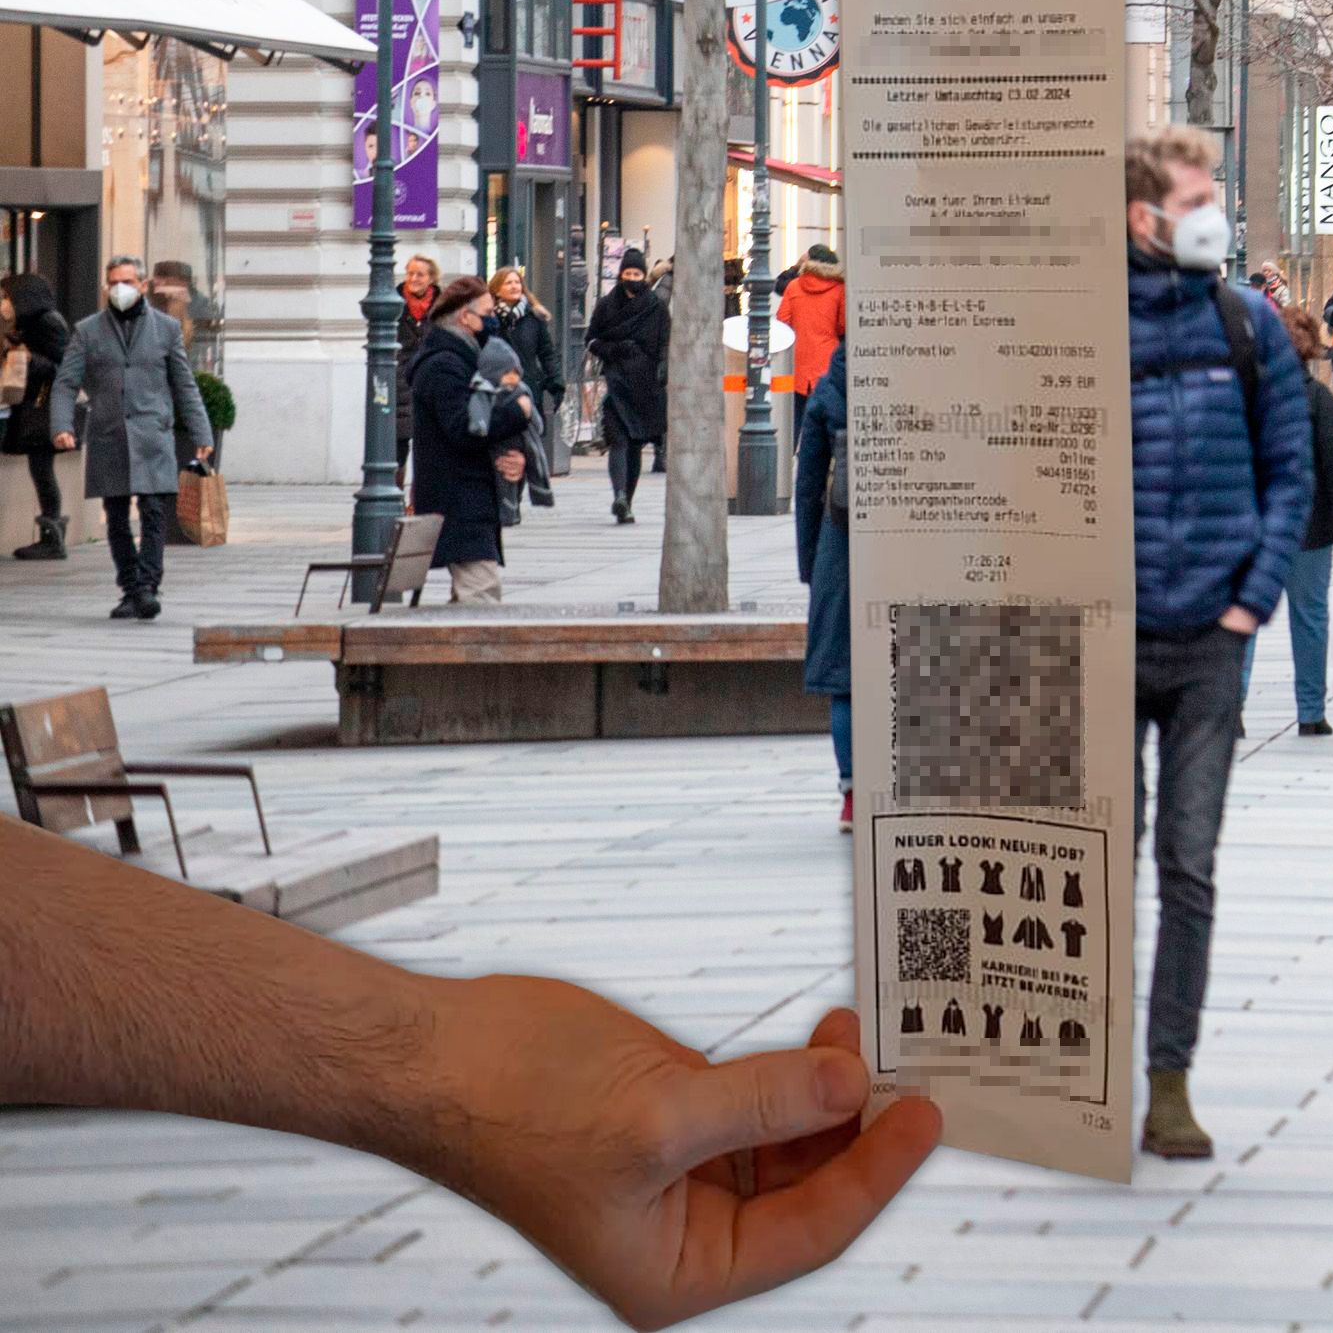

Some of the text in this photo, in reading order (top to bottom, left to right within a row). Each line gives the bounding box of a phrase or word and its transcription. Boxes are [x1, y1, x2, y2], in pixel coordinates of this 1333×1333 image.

[916, 13, 934, 26] Sie
[970, 12, 1014, 26] einfach
[743, 29, 840, 70] VENNA
[887, 89, 928, 103] Letzter
[934, 89, 1003, 103] Umtauschtag
[863, 119, 882, 132] Die
[887, 119, 960, 133] gesetzlichen
[923, 135, 966, 148] bleiben
[905, 195, 937, 208] Danke
[972, 195, 1004, 207] Ihren
[858, 315, 1016, 329] Bezahlung American Express
[853, 345, 956, 358] Zusatzinformation
[853, 376, 889, 389] Betrag
[1077, 376, 1096, 389] EUR
[854, 449, 1096, 466] Kontaktlos Chip Online
[855, 480, 976, 493] Autorisierungsnummer
[855, 495, 1008, 508] Autorisierungsantwortcode
[909, 510, 989, 523] Autorisierung
[894, 834, 1085, 862] NEUER LOOK! NEUER JOB?
[1041, 968, 1061, 983] BEI
[1063, 972, 1089, 988] P&C
[981, 973, 1089, 1003] JETZT BEWERBEN
